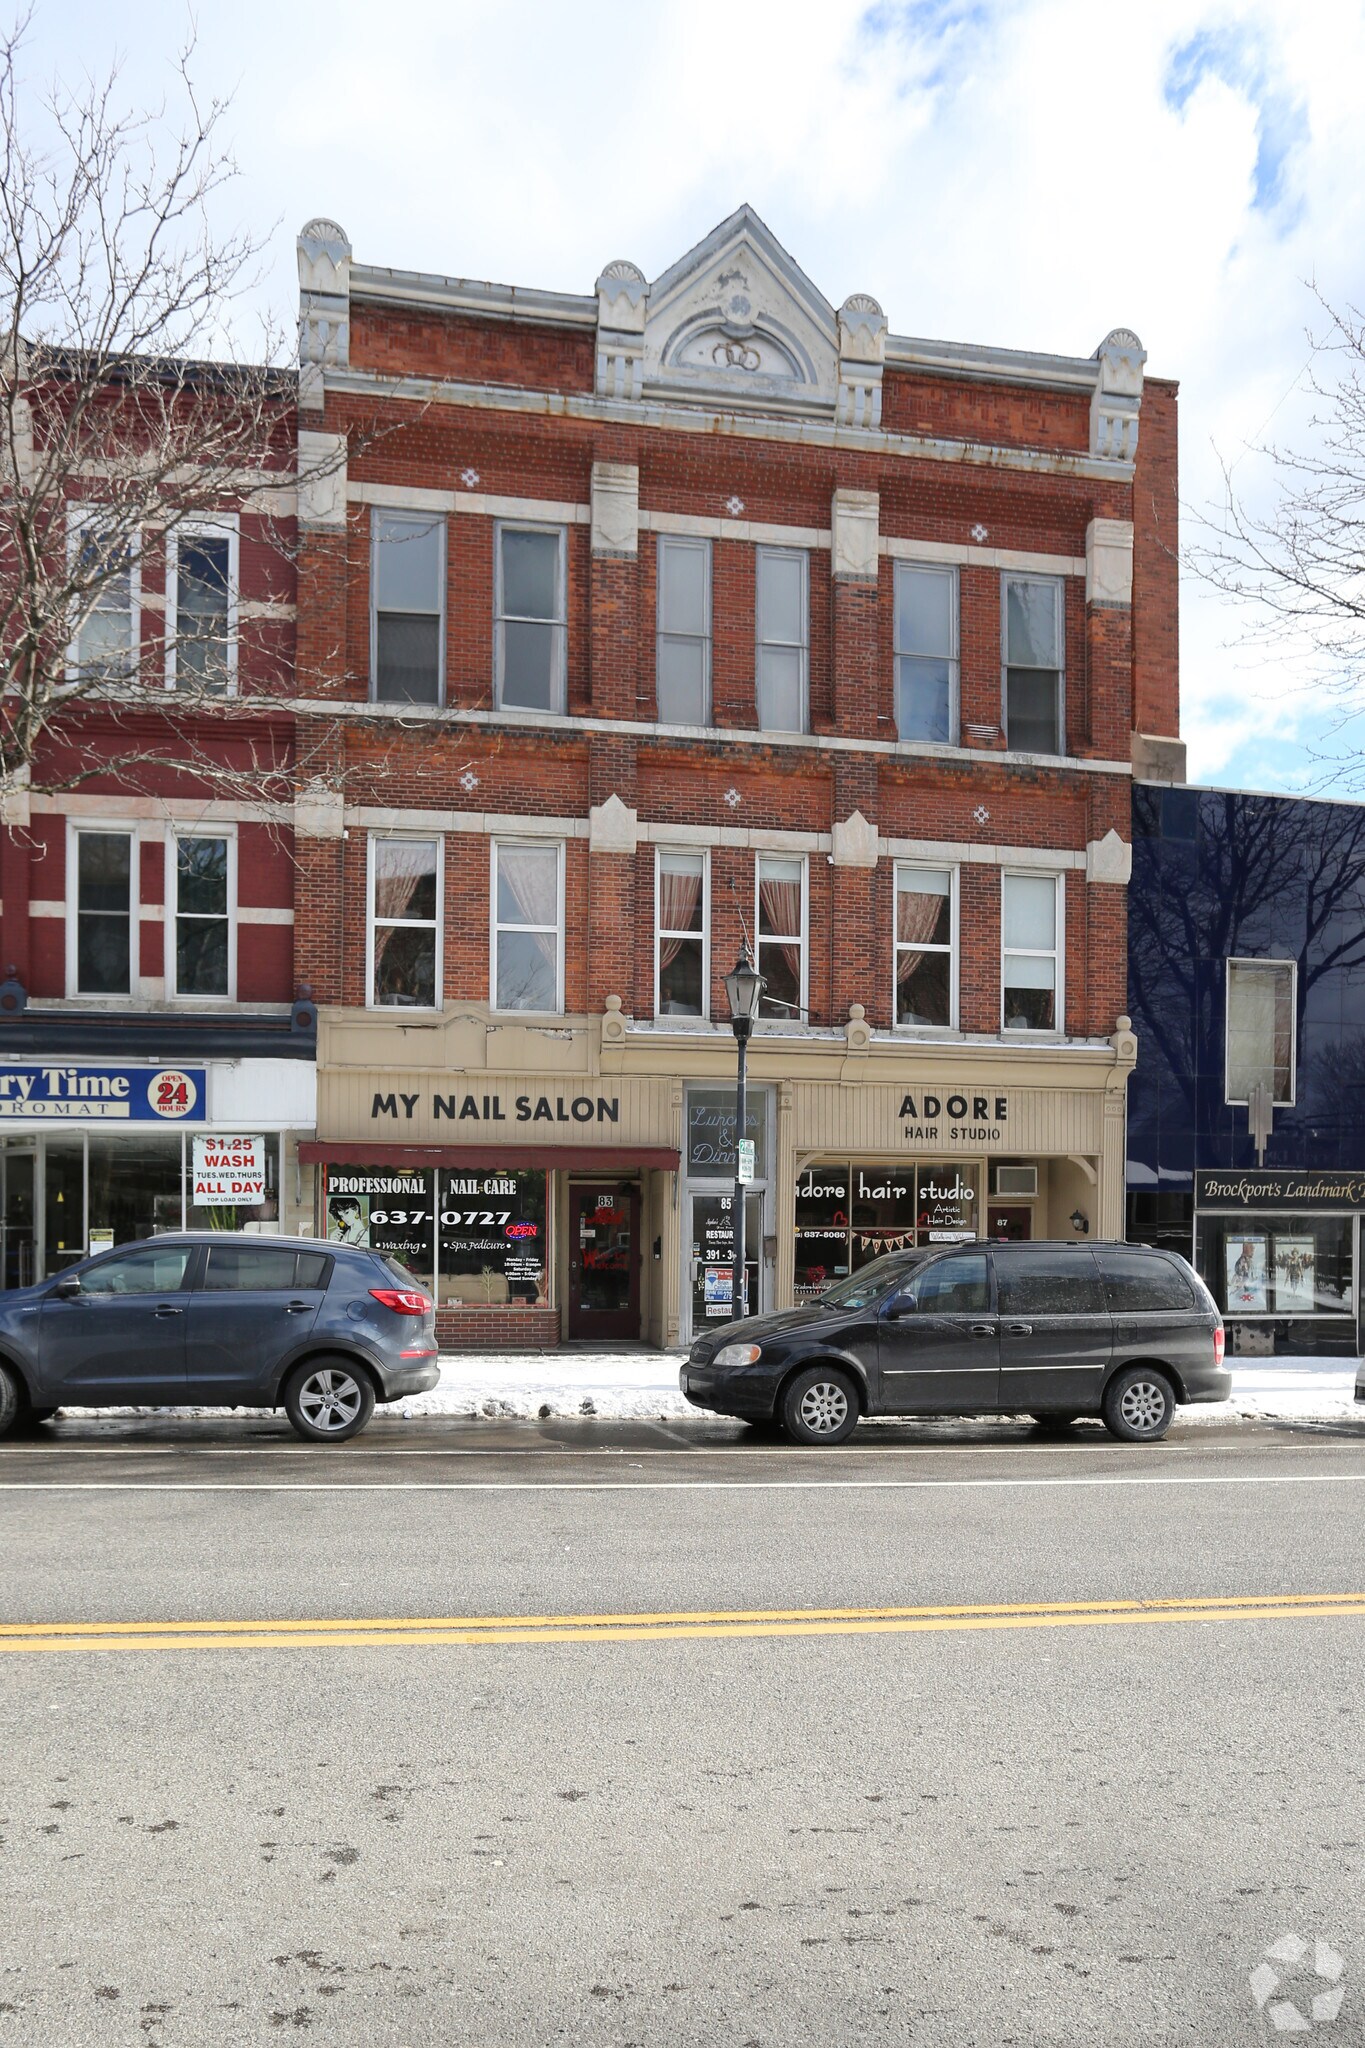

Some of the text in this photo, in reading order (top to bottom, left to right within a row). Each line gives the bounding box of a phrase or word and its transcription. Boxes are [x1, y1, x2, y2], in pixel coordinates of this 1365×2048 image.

[42, 1069, 130, 1097] Time
[162, 1074, 183, 1082] OPEN
[157, 1083, 188, 1104] 24
[0, 1102, 110, 1115] ROMAT
[371, 1093, 619, 1122] MY NAIL SALON
[899, 1095, 1007, 1120] ADORE
[690, 1107, 759, 1126] Lunces
[718, 1128, 733, 1147] &
[905, 1126, 1000, 1141] HAIR STUDIO
[206, 1138, 252, 1151] $1.25
[204, 1155, 255, 1167] WASH
[195, 1182, 225, 1193] ALL
[232, 1182, 263, 1193] DAY
[329, 1177, 517, 1195] PROFESSIONAL NAIL CARE
[858, 1171, 907, 1199] hair
[919, 1173, 974, 1200] studio
[1205, 1178, 1281, 1204] Brockport's
[1284, 1180, 1359, 1203] Landmark
[599, 1196, 613, 1207] 83
[721, 1197, 732, 1210] 85
[933, 1203, 960, 1214] Artistic
[927, 1214, 967, 1226] Hair Design
[505, 1225, 538, 1236] OPEN
[706, 1230, 734, 1239] RESTAUR
[382, 1239, 420, 1254] Waxing
[449, 1240, 467, 1253] Spa
[862, 1236, 904, 1250] LOVE
[706, 1249, 720, 1260] 391
